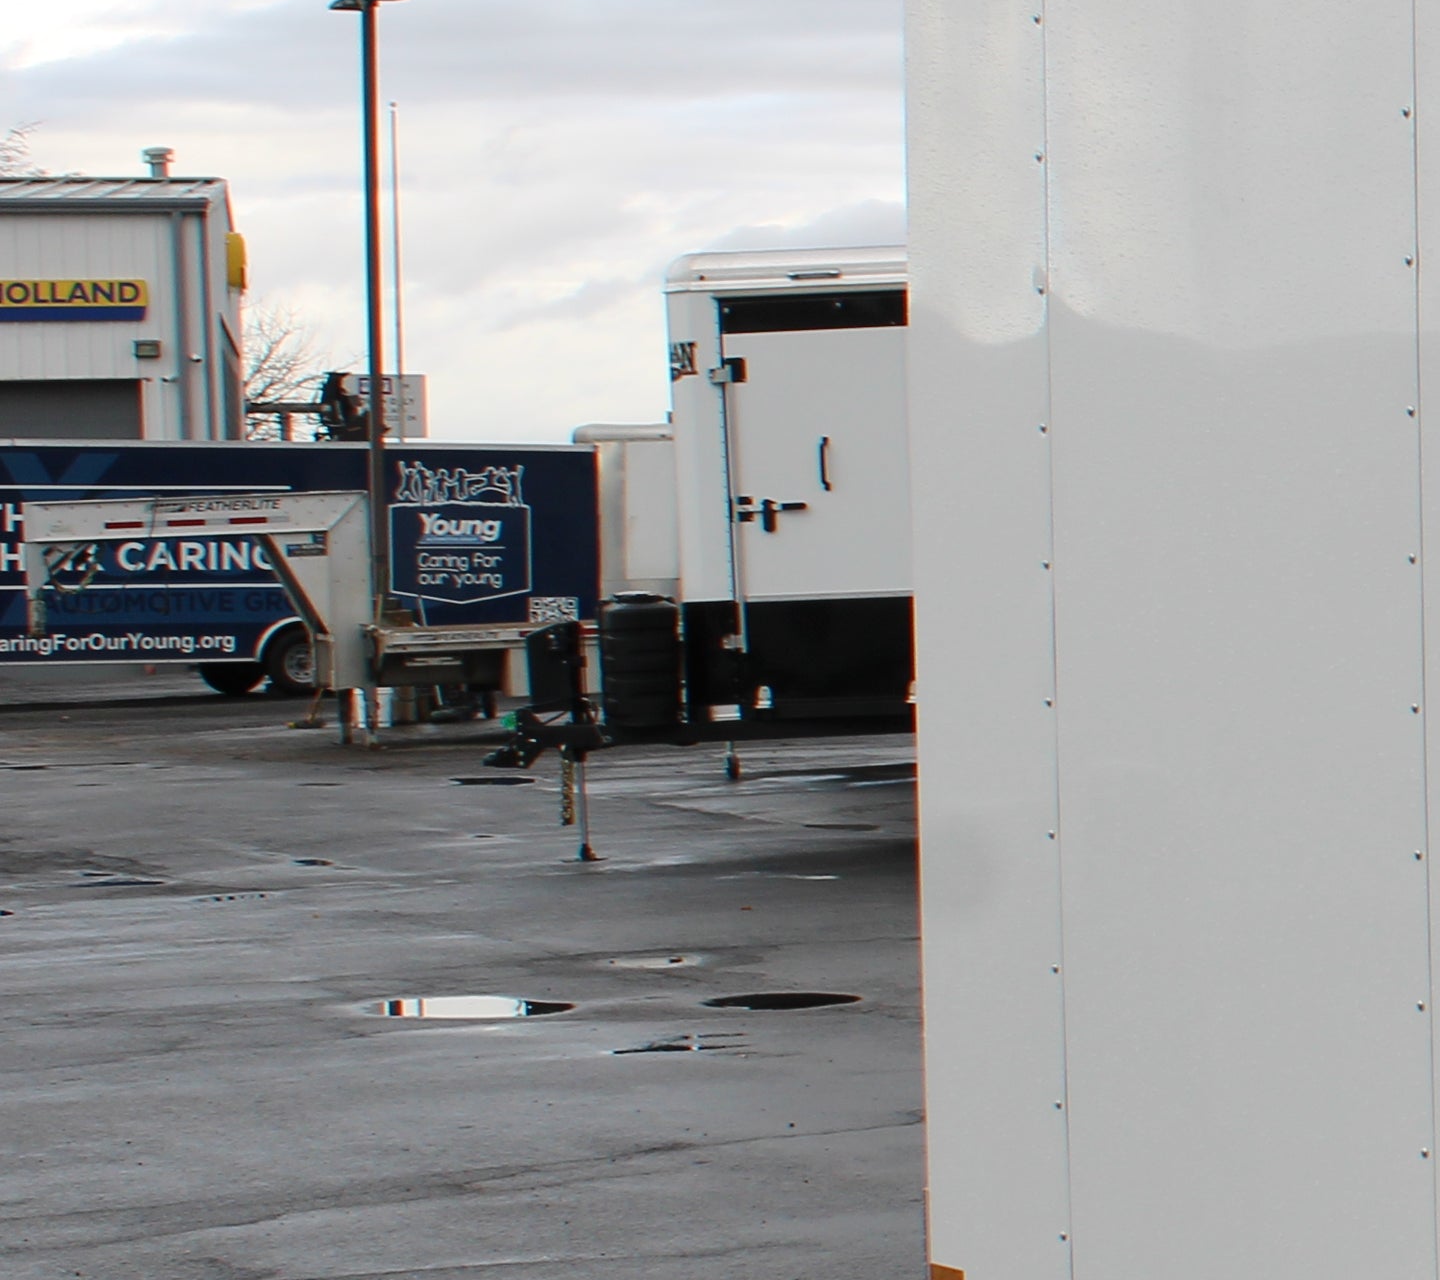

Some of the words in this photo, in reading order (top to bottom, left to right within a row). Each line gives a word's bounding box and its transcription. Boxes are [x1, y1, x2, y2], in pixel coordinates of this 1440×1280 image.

[0, 281, 140, 304] OLLAND
[188, 497, 282, 513] FEATHERLITE
[418, 512, 503, 542] Young
[417, 552, 470, 572] Caring
[418, 573, 450, 586] our
[451, 572, 503, 588] young
